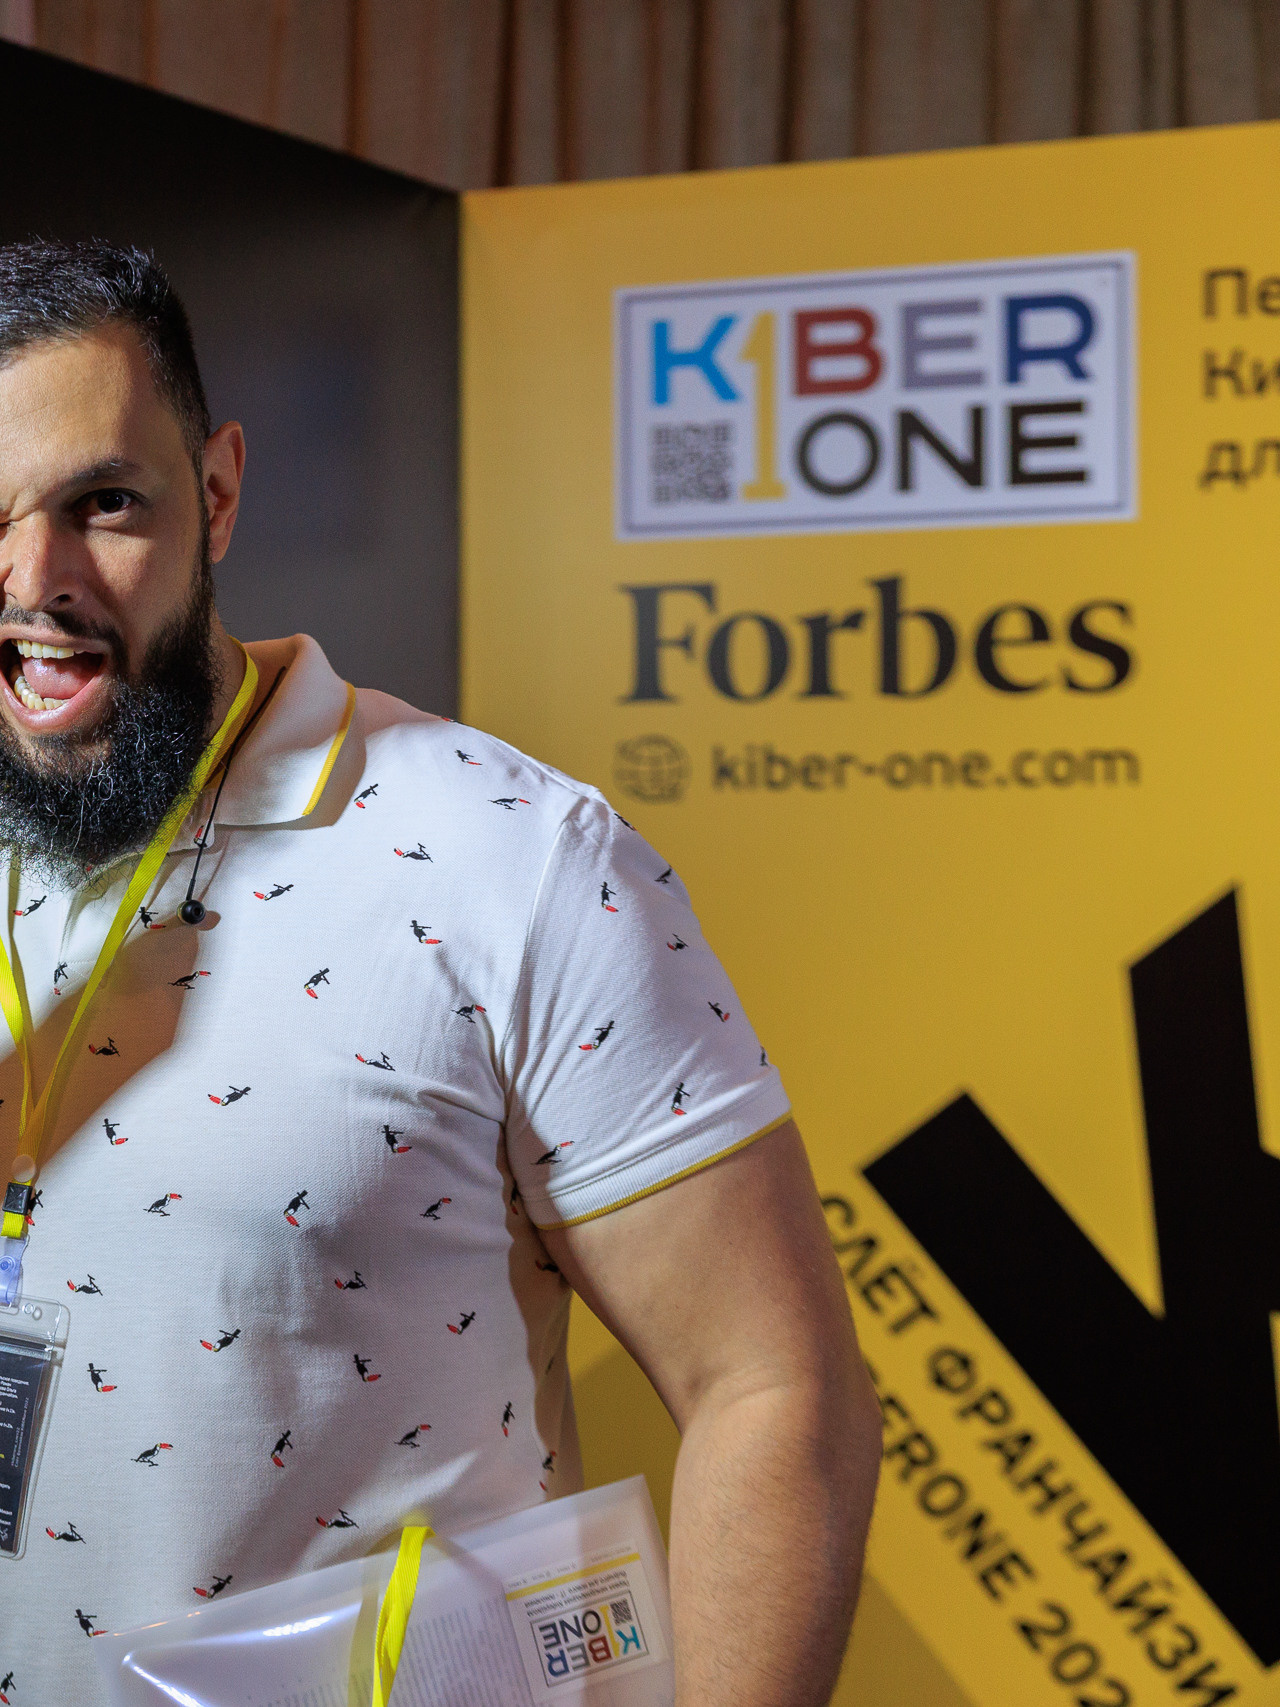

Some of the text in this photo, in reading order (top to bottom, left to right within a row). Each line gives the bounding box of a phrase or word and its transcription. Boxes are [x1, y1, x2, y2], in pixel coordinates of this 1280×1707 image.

[793, 400, 1090, 499] ONE
[617, 573, 1136, 705] Forbes
[713, 744, 1141, 793] kiber-one.com
[866, 1360, 1036, 1602] ERONE
